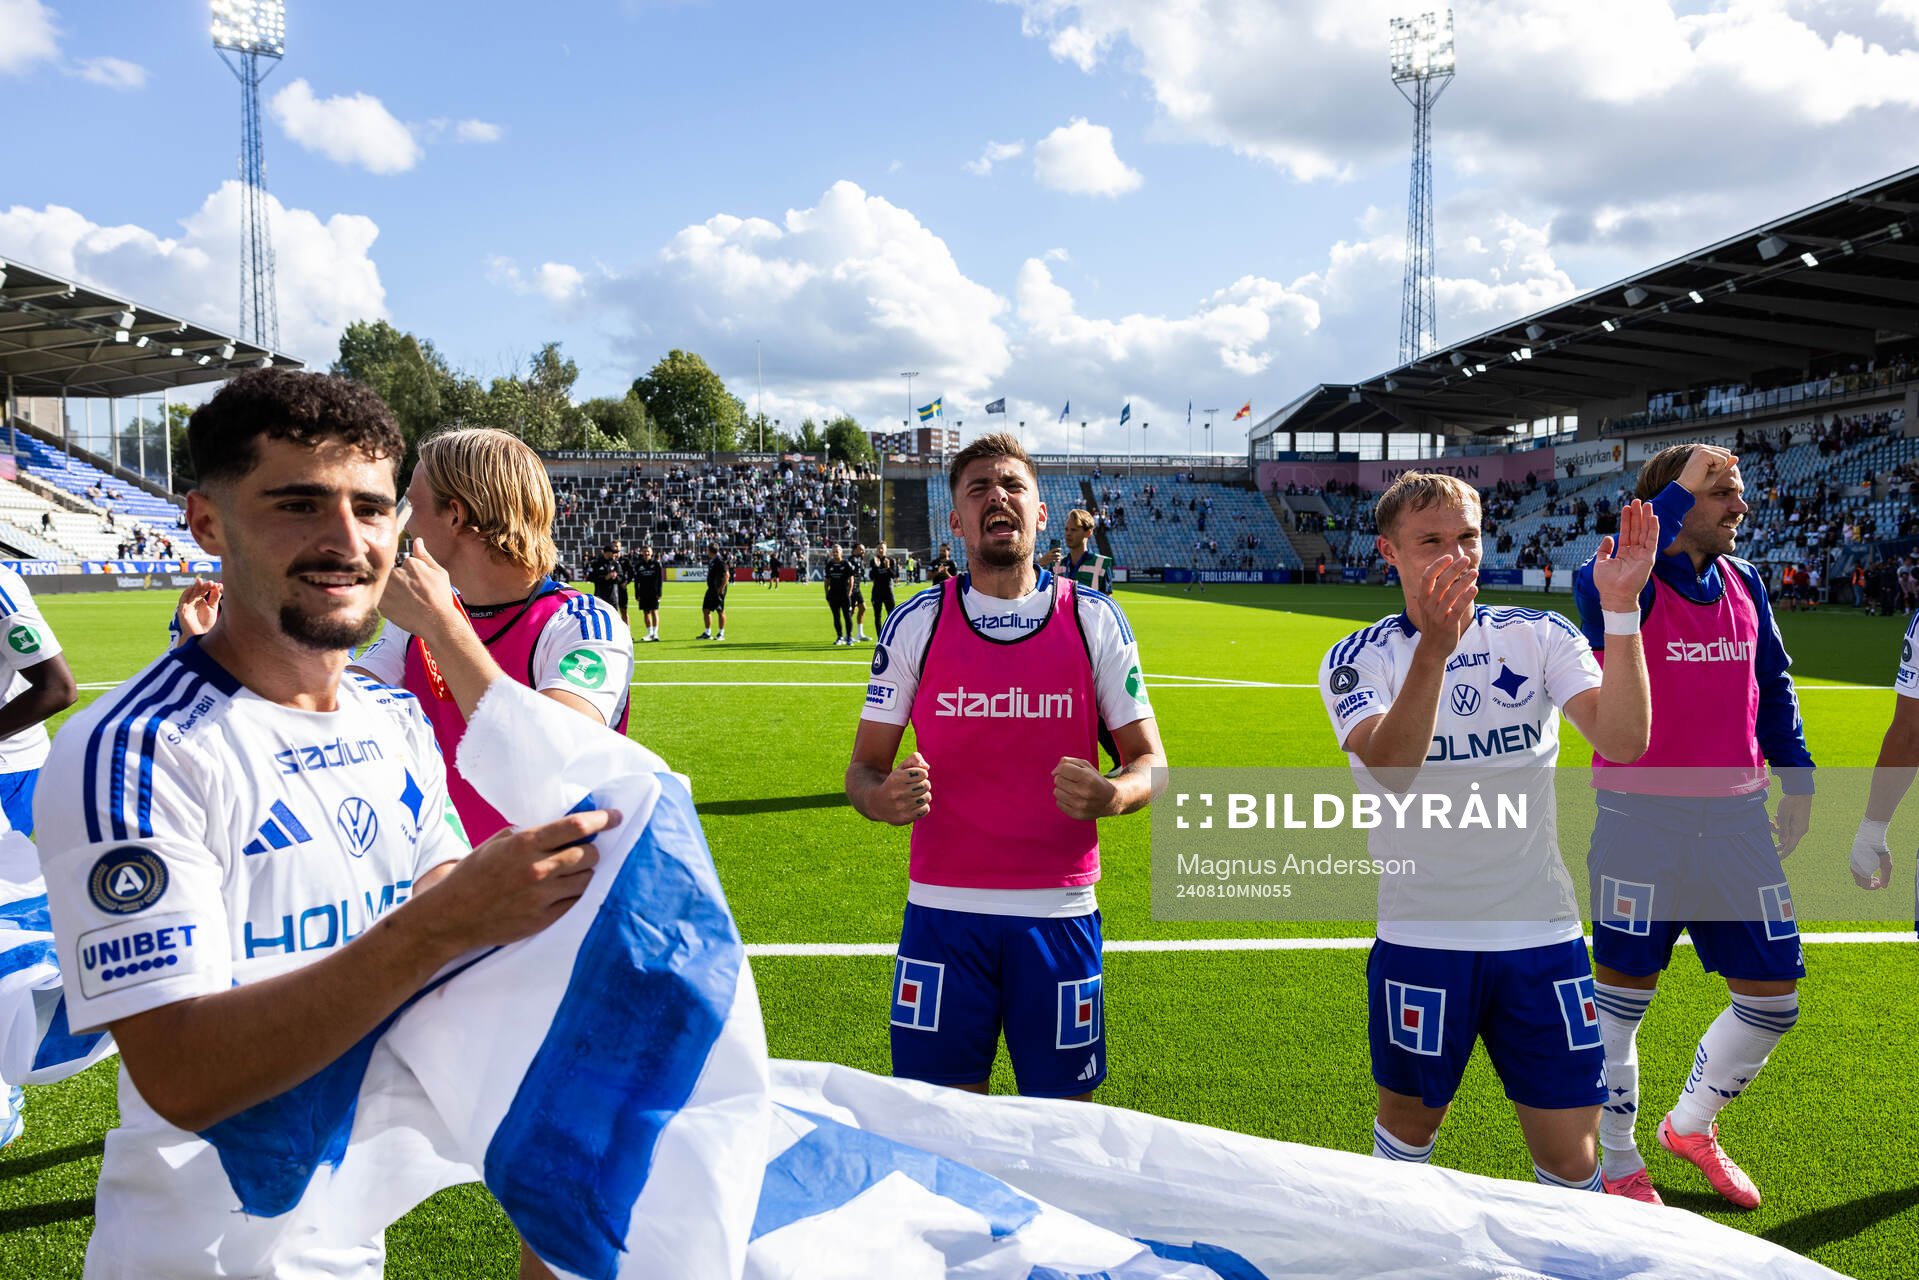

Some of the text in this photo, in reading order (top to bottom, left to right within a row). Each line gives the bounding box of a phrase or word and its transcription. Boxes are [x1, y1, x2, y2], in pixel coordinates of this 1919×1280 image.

[650, 452, 706, 460] FLYTTFIRMA!
[1382, 465, 1479, 482] INRSTAN
[1335, 690, 1375, 718] UNIBET
[273, 736, 384, 775] stadium
[82, 924, 197, 971] UNIBET
